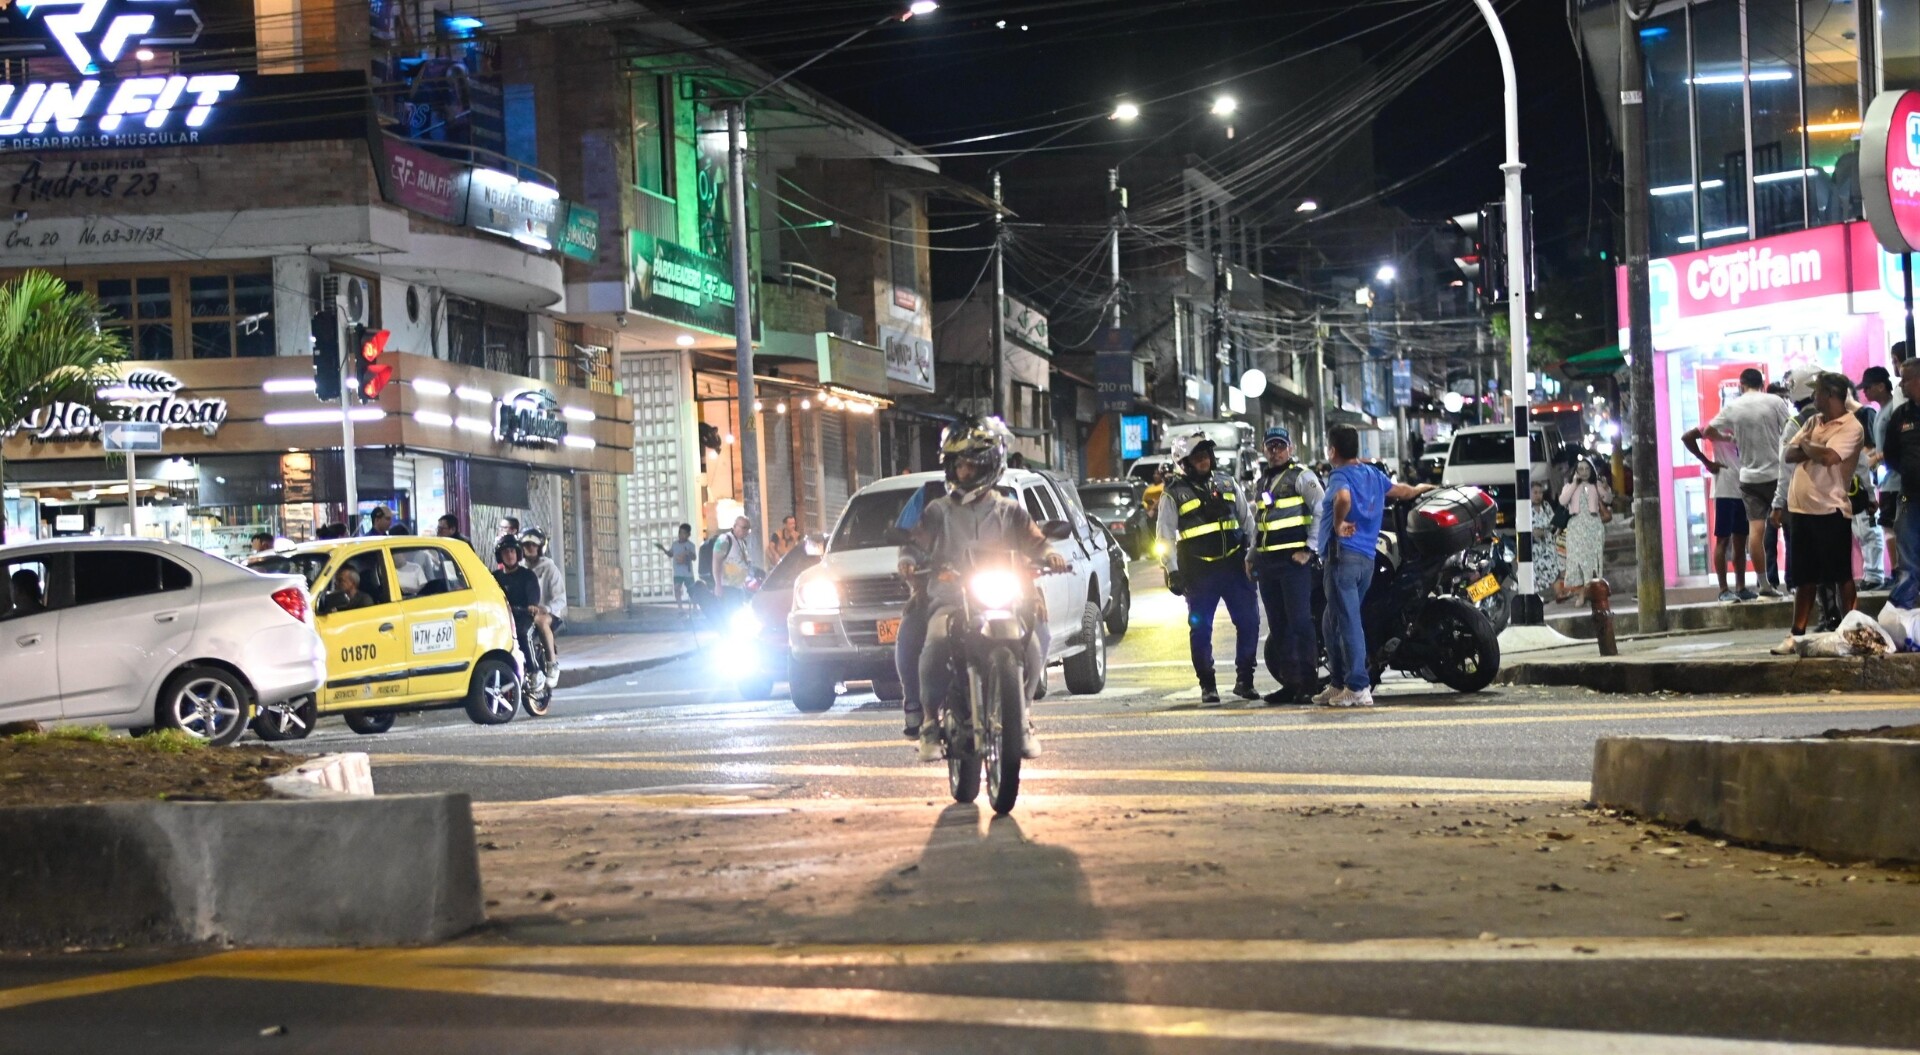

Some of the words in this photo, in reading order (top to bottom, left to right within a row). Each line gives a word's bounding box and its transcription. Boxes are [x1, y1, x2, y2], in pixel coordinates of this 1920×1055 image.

[99, 75, 240, 131] FIT
[13, 134, 110, 150] DESARROLLO
[115, 131, 200, 147] MUSCULAR
[123, 172, 160, 198] 23
[416, 168, 436, 192] RUN
[40, 231, 59, 246] 20
[1687, 247, 1822, 305] Copifam
[1097, 381, 1116, 393] 210
[341, 644, 376, 662] 01870
